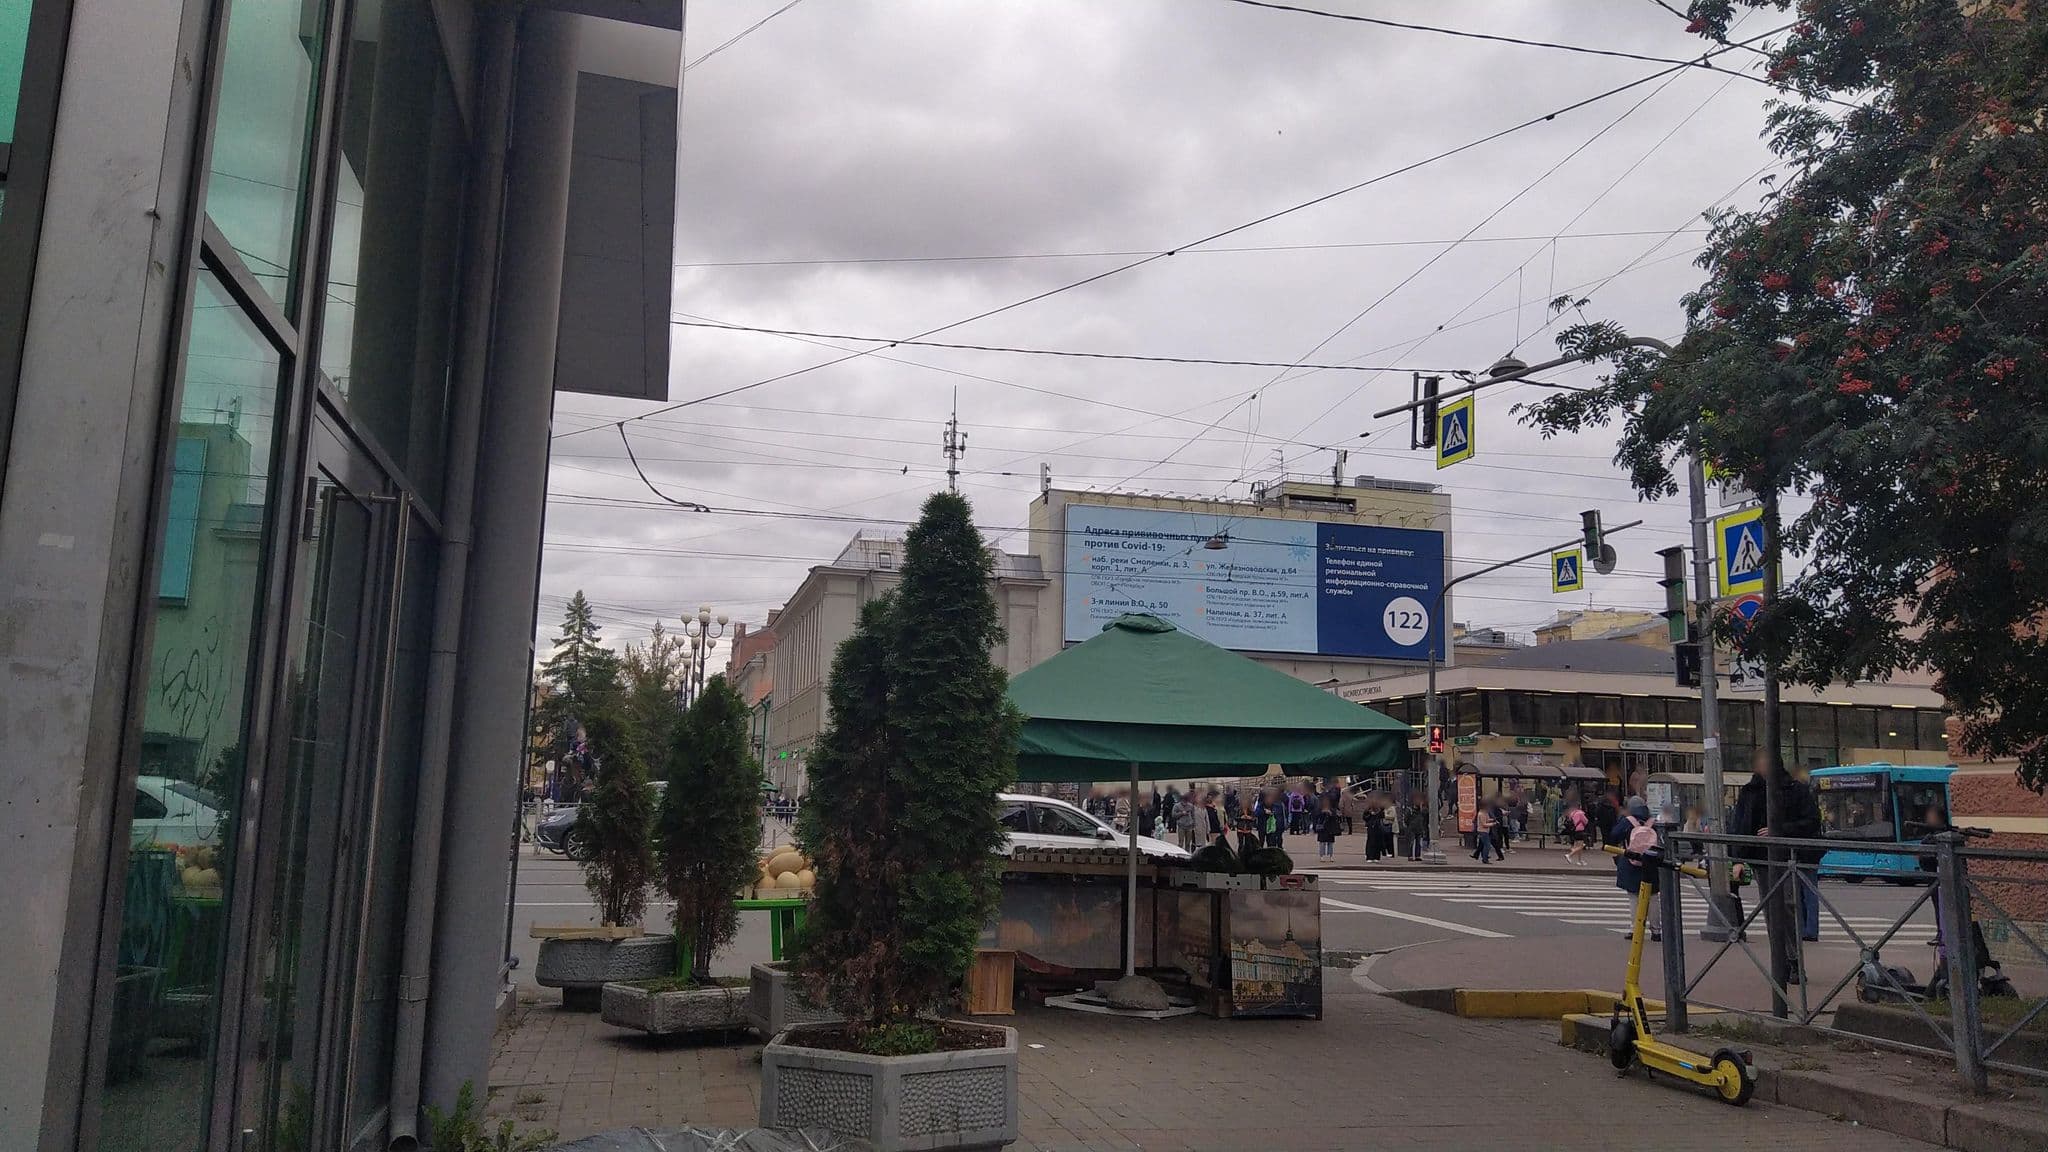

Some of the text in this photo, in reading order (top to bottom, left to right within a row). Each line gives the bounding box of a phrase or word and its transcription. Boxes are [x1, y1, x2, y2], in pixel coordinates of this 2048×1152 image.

[1085, 525, 1120, 537] Адреса
[1122, 529, 1190, 542] прививочных
[1084, 540, 1166, 552] против Covid-19:
[1091, 555, 1109, 563] наб.
[1110, 557, 1129, 565] реки
[1130, 557, 1171, 567] Смоленки,
[1183, 560, 1190, 569] 3,
[1325, 557, 1383, 568] Телефон единой
[1091, 564, 1113, 573] корп.
[1115, 564, 1122, 573] 1,
[1281, 567, 1297, 575] д.64
[1325, 568, 1376, 577] региональной
[1325, 578, 1429, 590] информационно-справочной
[1206, 586, 1238, 595] Большой
[1239, 589, 1250, 597] пр.
[1325, 587, 1353, 596] службы
[1091, 597, 1104, 605] 3-я
[1104, 599, 1130, 607] линия
[1158, 601, 1169, 609] 50
[1206, 608, 1243, 617] Наличная,
[1253, 611, 1264, 619] 37,
[1388, 610, 1423, 630] 122
